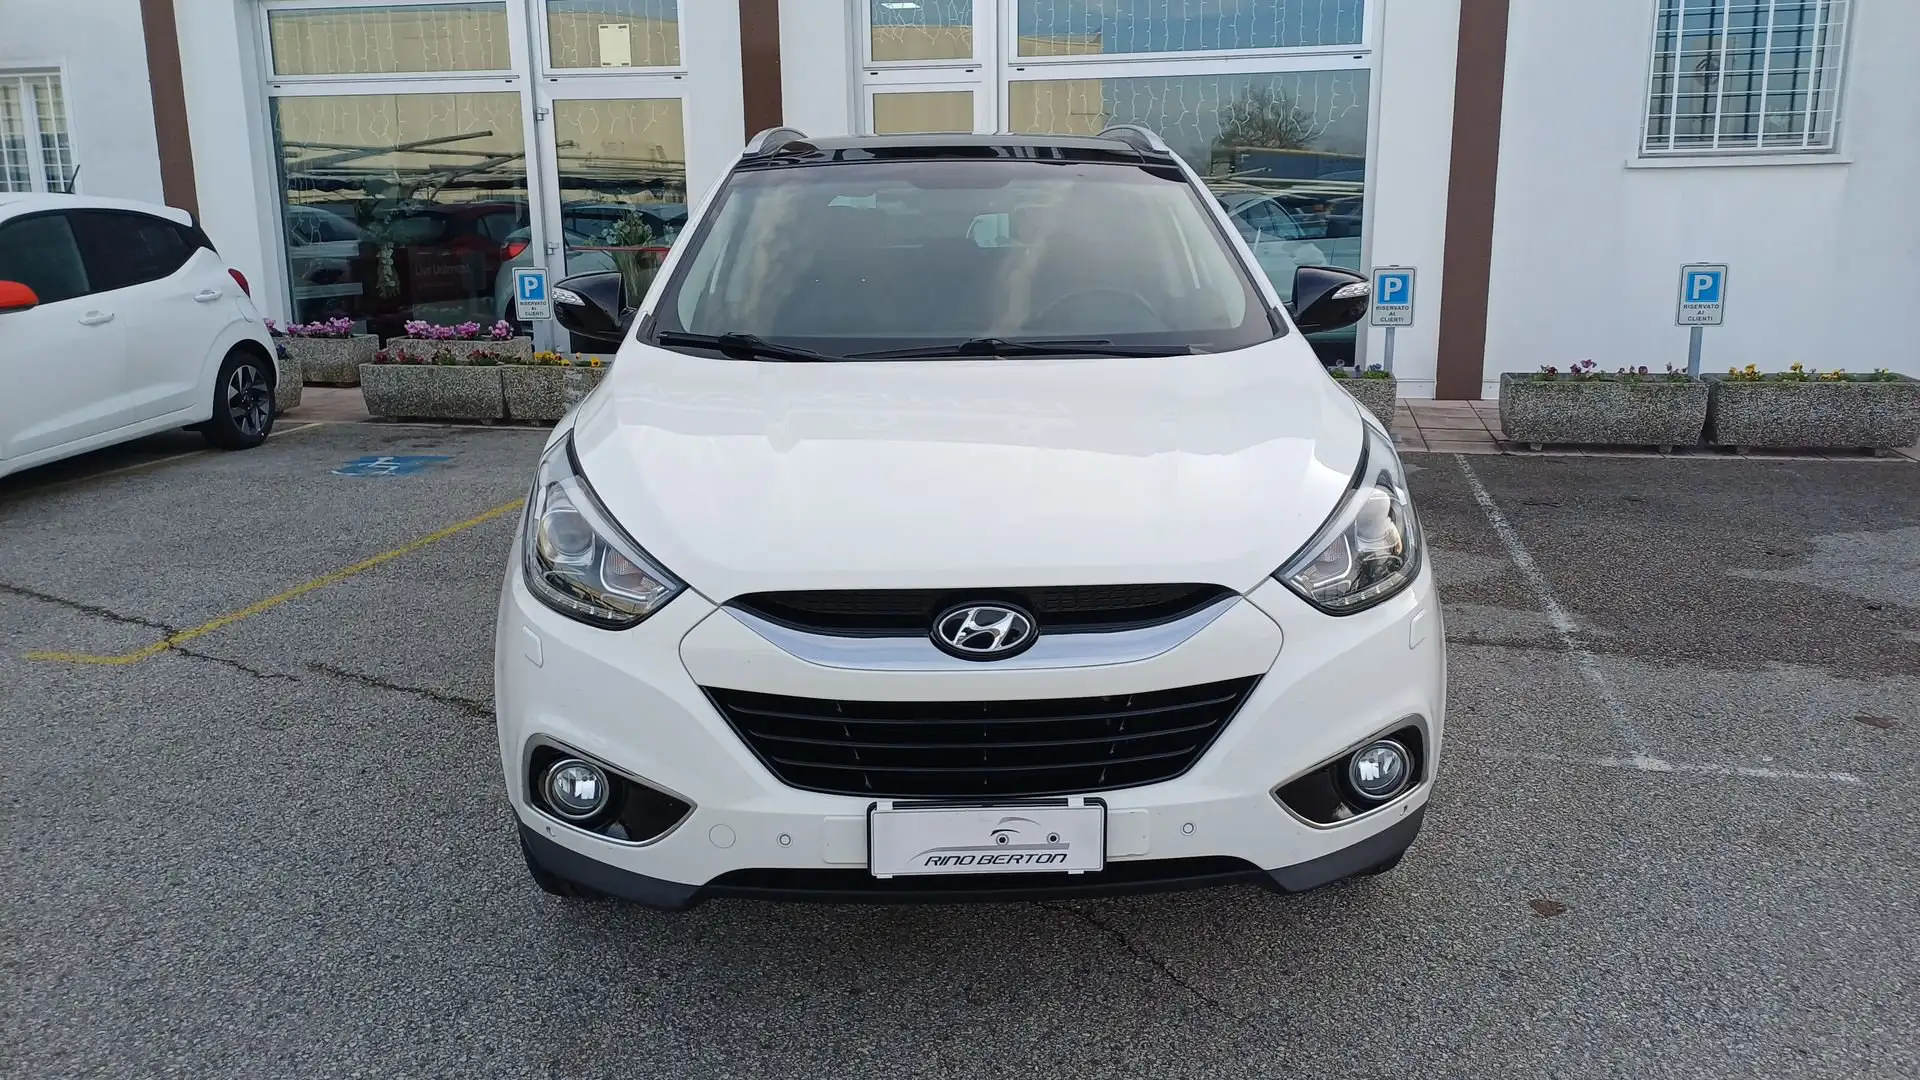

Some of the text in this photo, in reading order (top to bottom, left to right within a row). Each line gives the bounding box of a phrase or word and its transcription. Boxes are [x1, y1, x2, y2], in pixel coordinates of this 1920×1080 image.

[524, 276, 539, 298] P
[1384, 277, 1402, 301] P
[1692, 274, 1713, 299] P
[924, 853, 1068, 866] RINO BERTON
